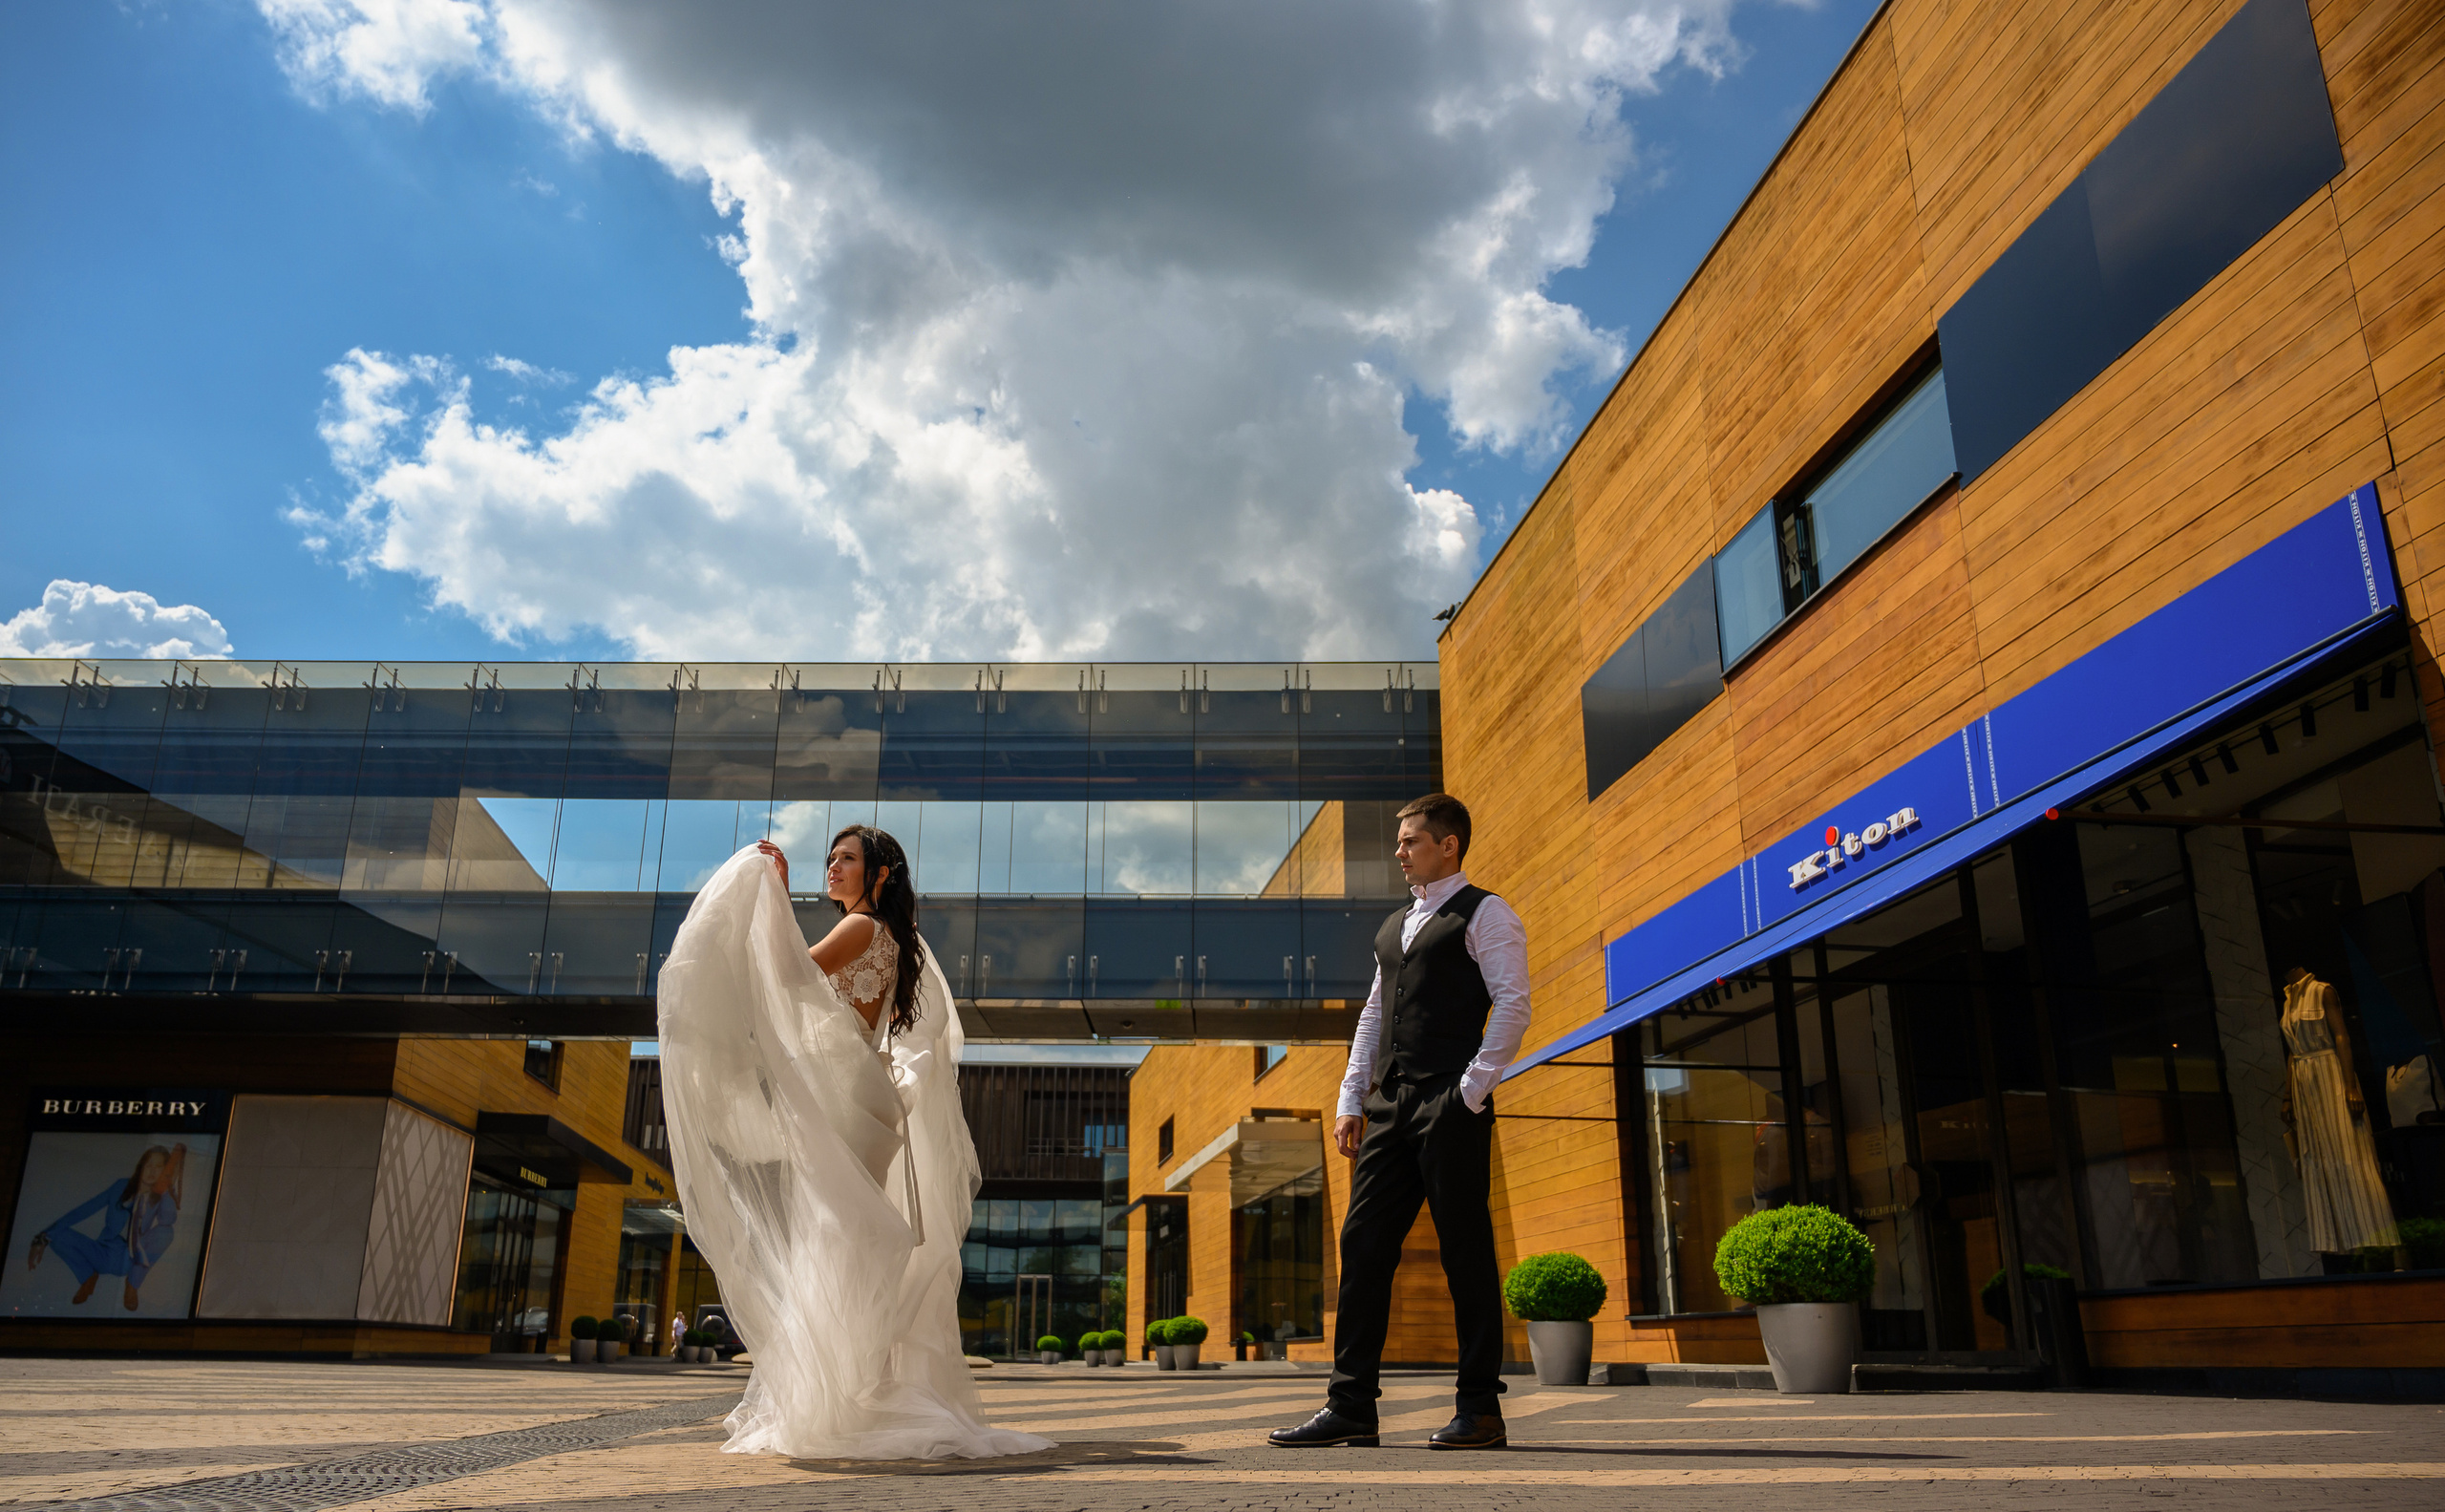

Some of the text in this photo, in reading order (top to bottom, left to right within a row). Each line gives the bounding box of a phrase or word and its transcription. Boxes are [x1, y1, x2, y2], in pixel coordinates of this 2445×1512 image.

[2351, 502, 2377, 606] KITON KITON KITON
[1787, 807, 1920, 888] Kiton
[42, 1098, 206, 1117] BURBERRY
